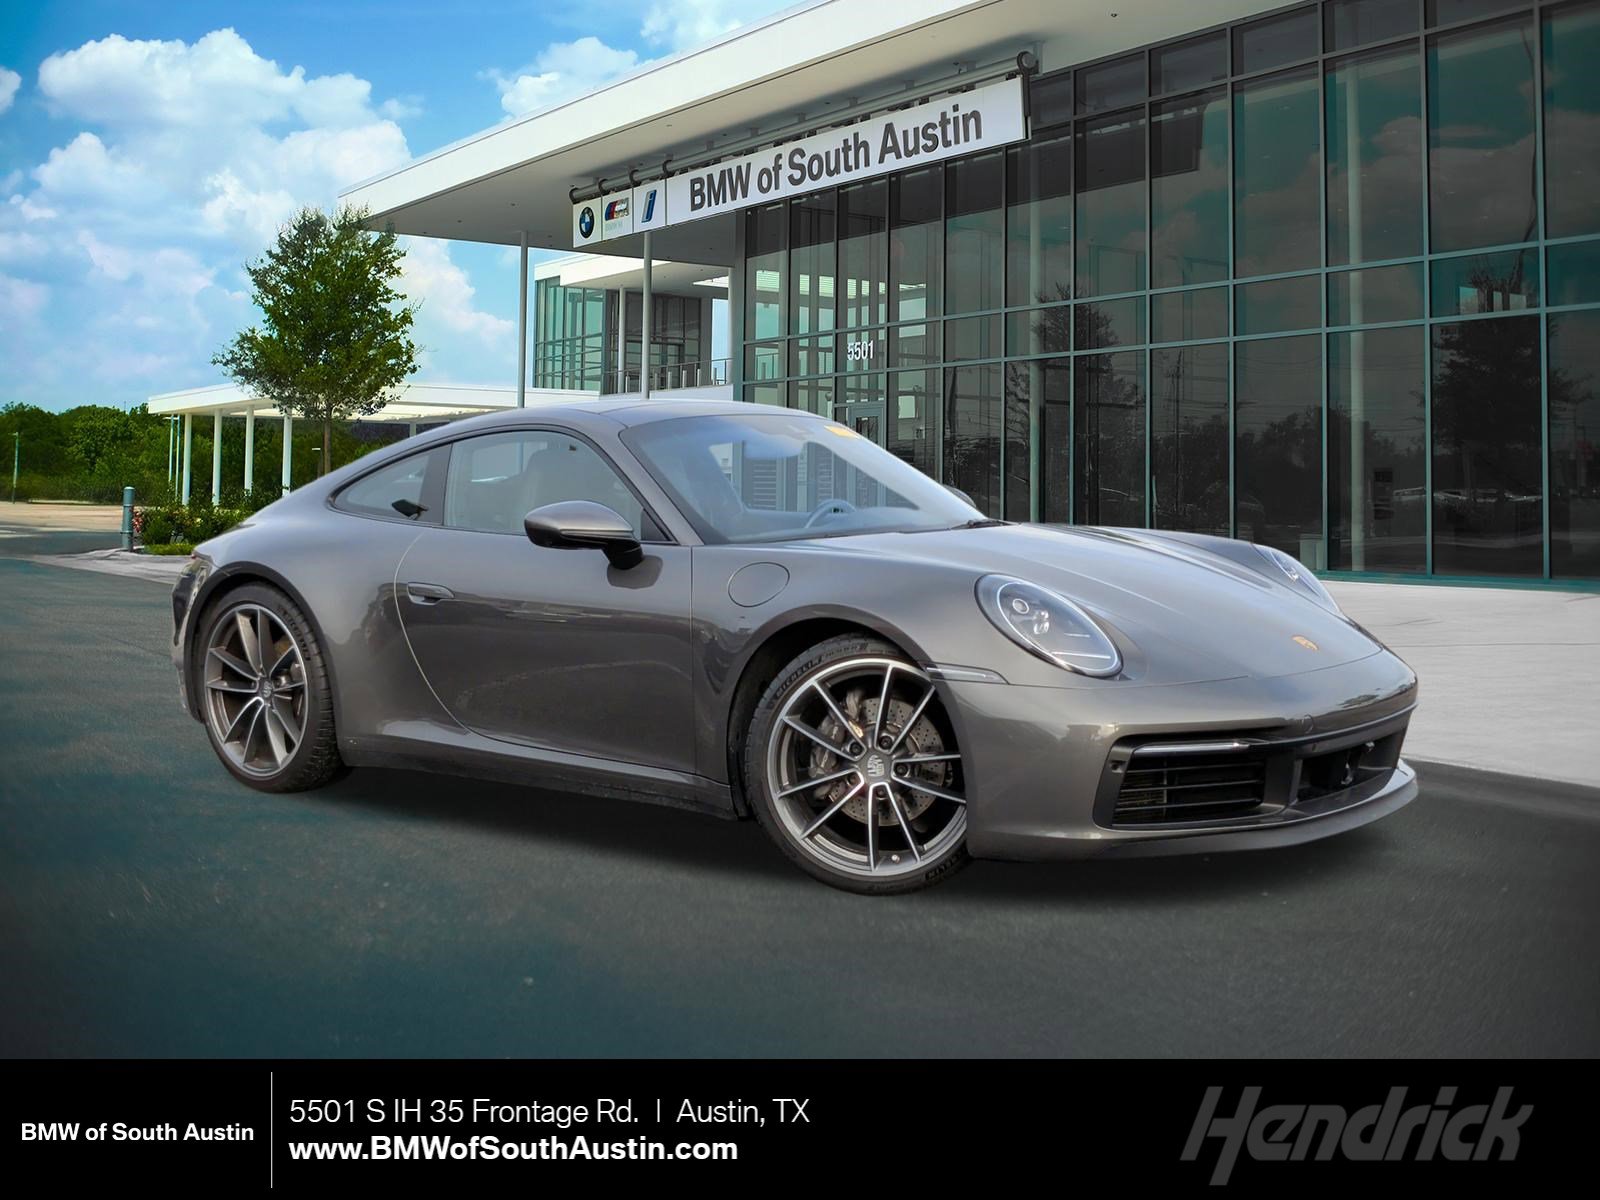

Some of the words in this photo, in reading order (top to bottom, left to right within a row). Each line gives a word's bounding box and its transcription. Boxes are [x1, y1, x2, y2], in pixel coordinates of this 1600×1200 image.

[690, 161, 751, 211] BMW
[757, 153, 783, 194] of
[787, 132, 870, 186] South
[878, 104, 982, 164] Austin
[847, 340, 874, 361] 5501
